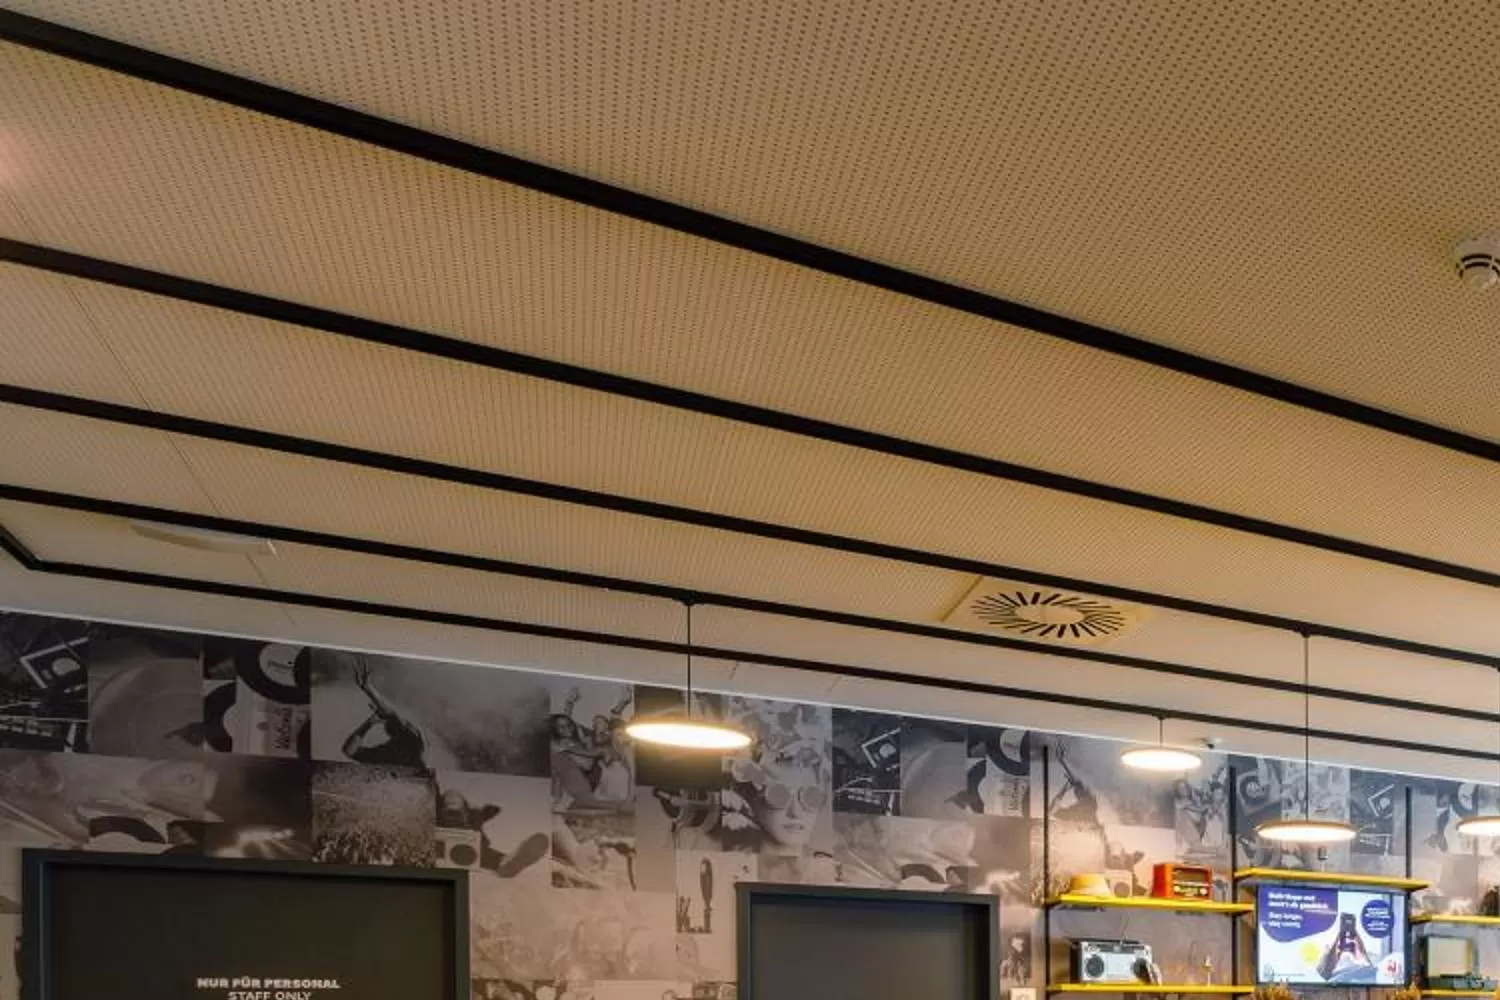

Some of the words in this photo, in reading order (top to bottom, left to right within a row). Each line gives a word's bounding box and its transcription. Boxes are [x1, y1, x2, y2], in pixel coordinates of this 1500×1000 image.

[196, 977, 229, 988] NUR
[232, 976, 261, 988] FÜR
[263, 979, 341, 989] PERSONAL
[228, 991, 271, 1000] STAFF
[275, 991, 312, 1000] ONLY
